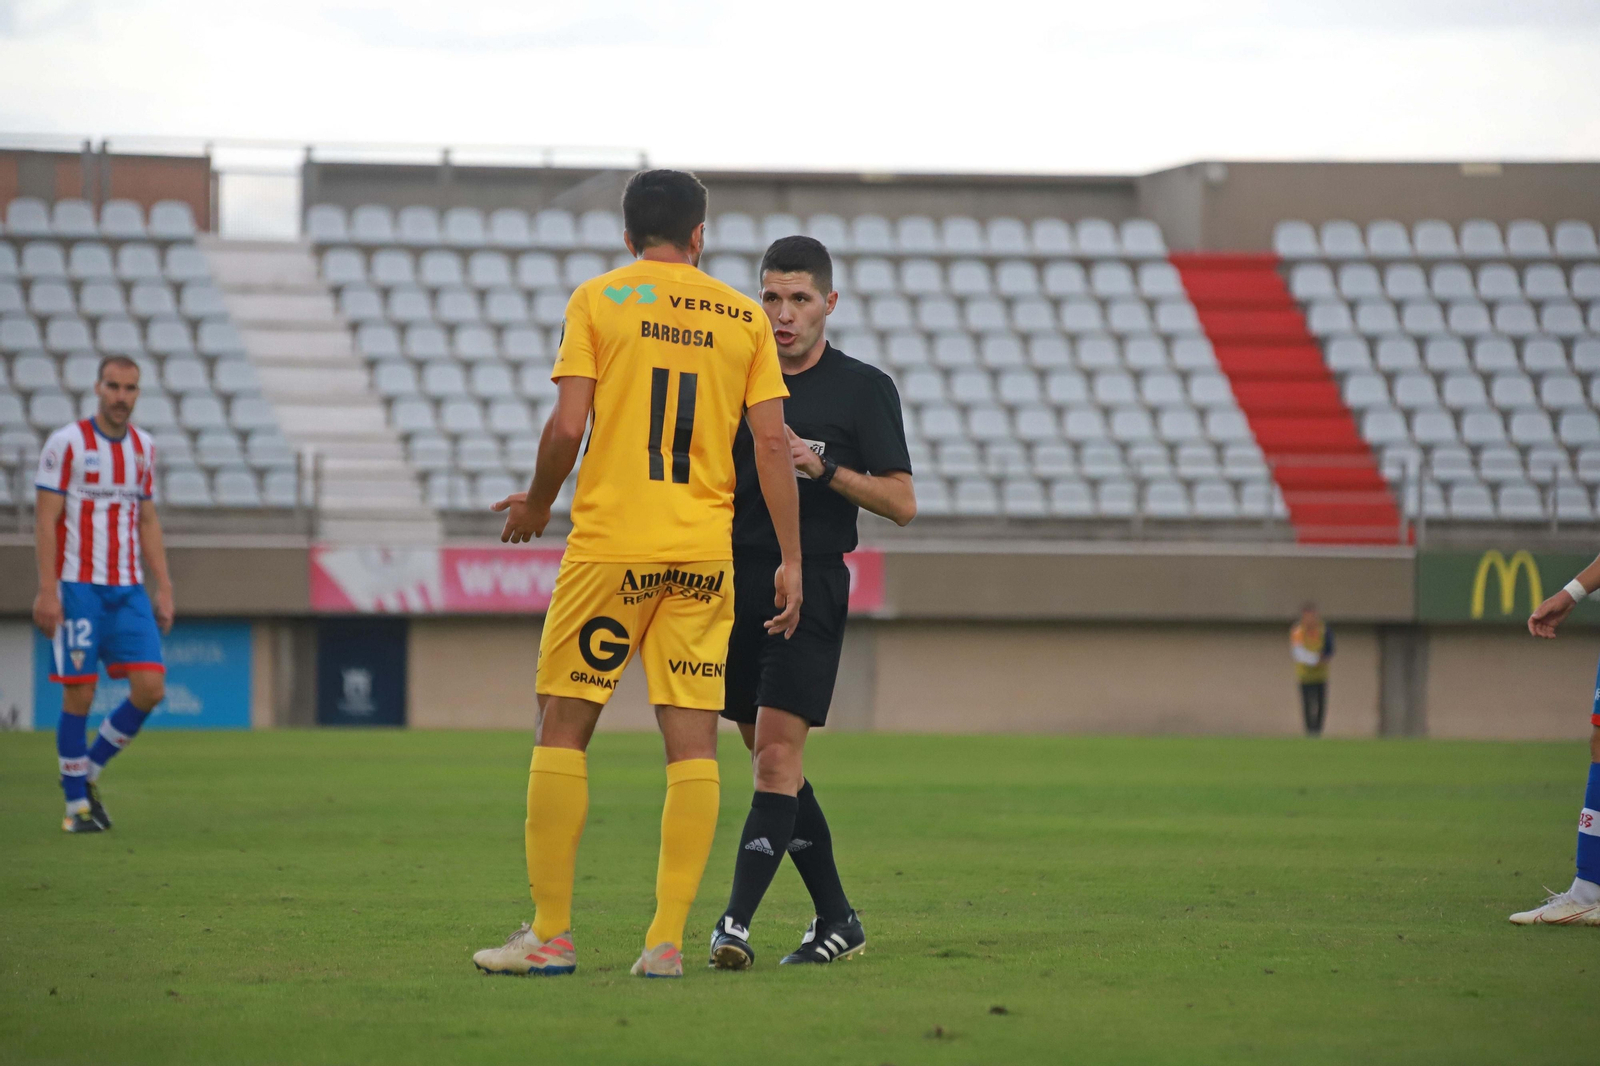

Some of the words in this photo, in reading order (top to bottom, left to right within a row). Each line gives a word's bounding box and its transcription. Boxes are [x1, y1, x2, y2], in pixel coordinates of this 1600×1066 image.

[669, 295, 753, 323] VERSUS
[641, 320, 714, 348] BARBOSA
[647, 367, 698, 484] 11
[65, 617, 93, 648] 12
[744, 843, 774, 856] adidas
